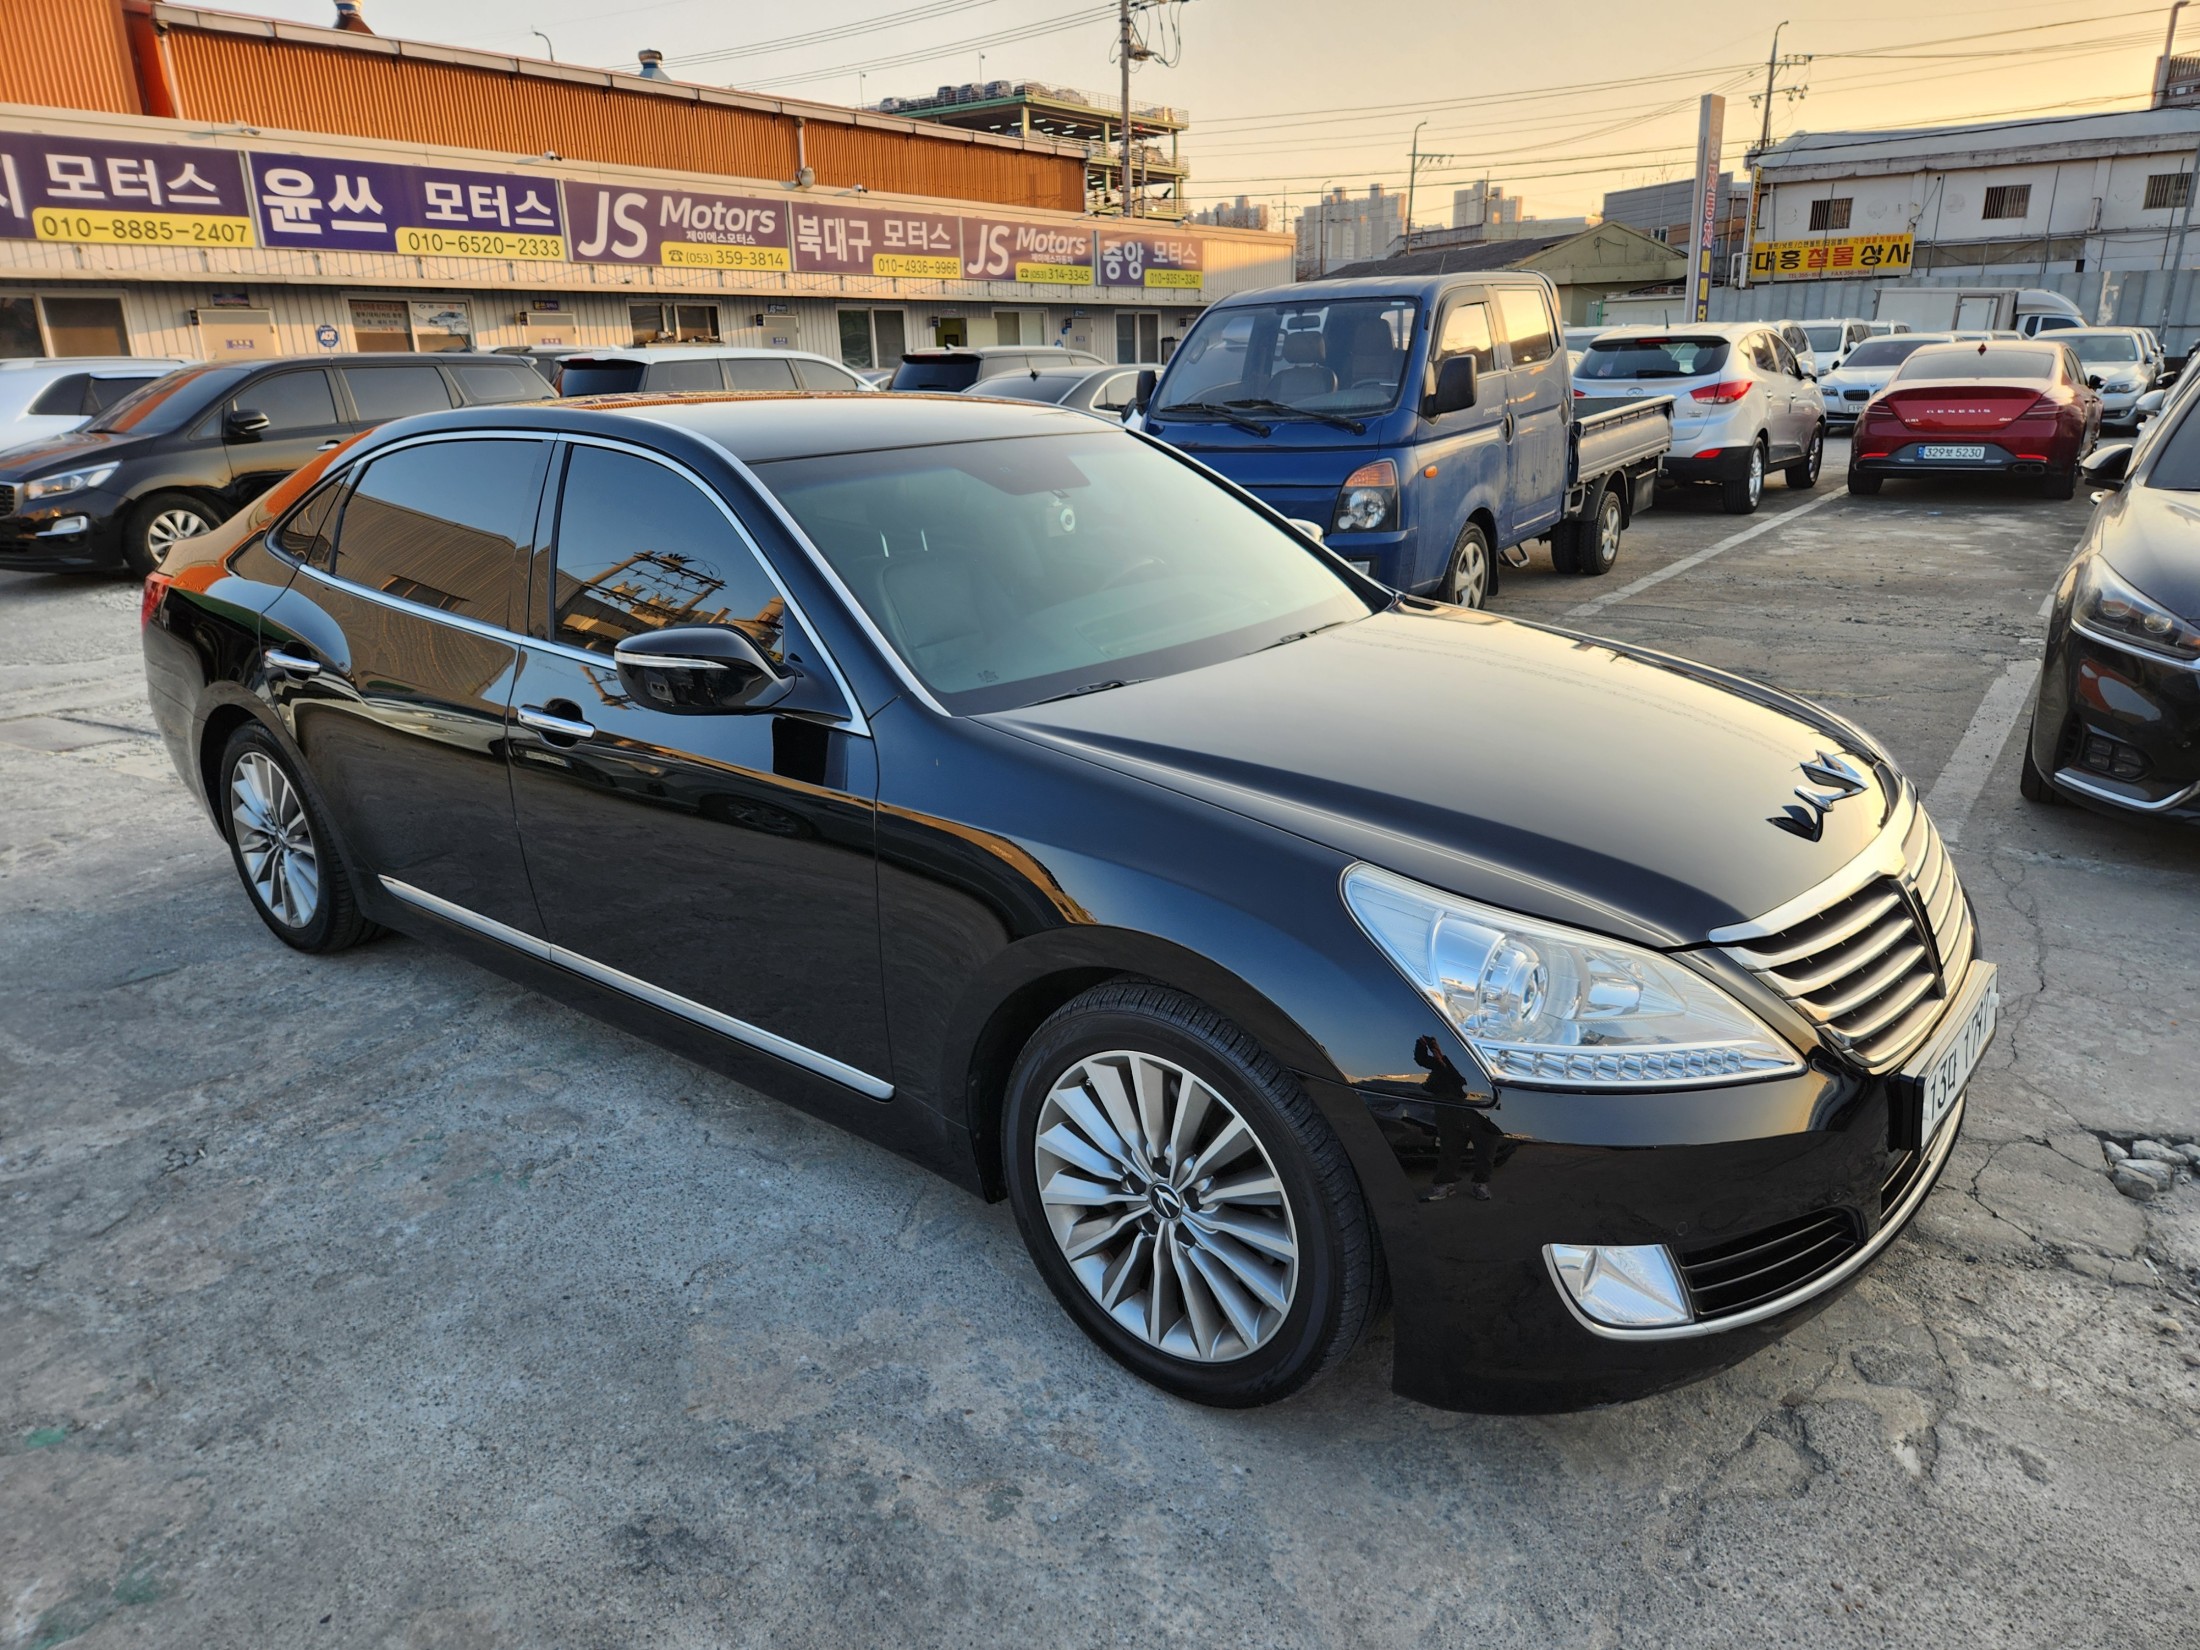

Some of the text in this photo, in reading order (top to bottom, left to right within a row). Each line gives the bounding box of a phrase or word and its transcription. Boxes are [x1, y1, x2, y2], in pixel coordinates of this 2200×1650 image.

[45, 153, 221, 205] 모터스
[262, 168, 555, 234] 윤쓰 모터스
[1702, 164, 1718, 247] 자동차
[42, 215, 247, 242] 010-8885-2407
[577, 191, 776, 258] JS Motors
[686, 230, 756, 245] 제이에스모터스
[797, 214, 952, 263] 북대구 모터스
[408, 232, 560, 257] 010-6520-2333
[686, 250, 784, 267] (053) 359-3814
[967, 224, 1086, 275] JS Motors
[1102, 240, 1197, 280] 중앙 모터스
[1755, 249, 1801, 271] 대흥
[1807, 245, 1854, 268] 철물
[1861, 243, 1911, 266] 상사
[878, 258, 958, 274] 010-4936-9966
[1955, 447, 1982, 458] 5230
